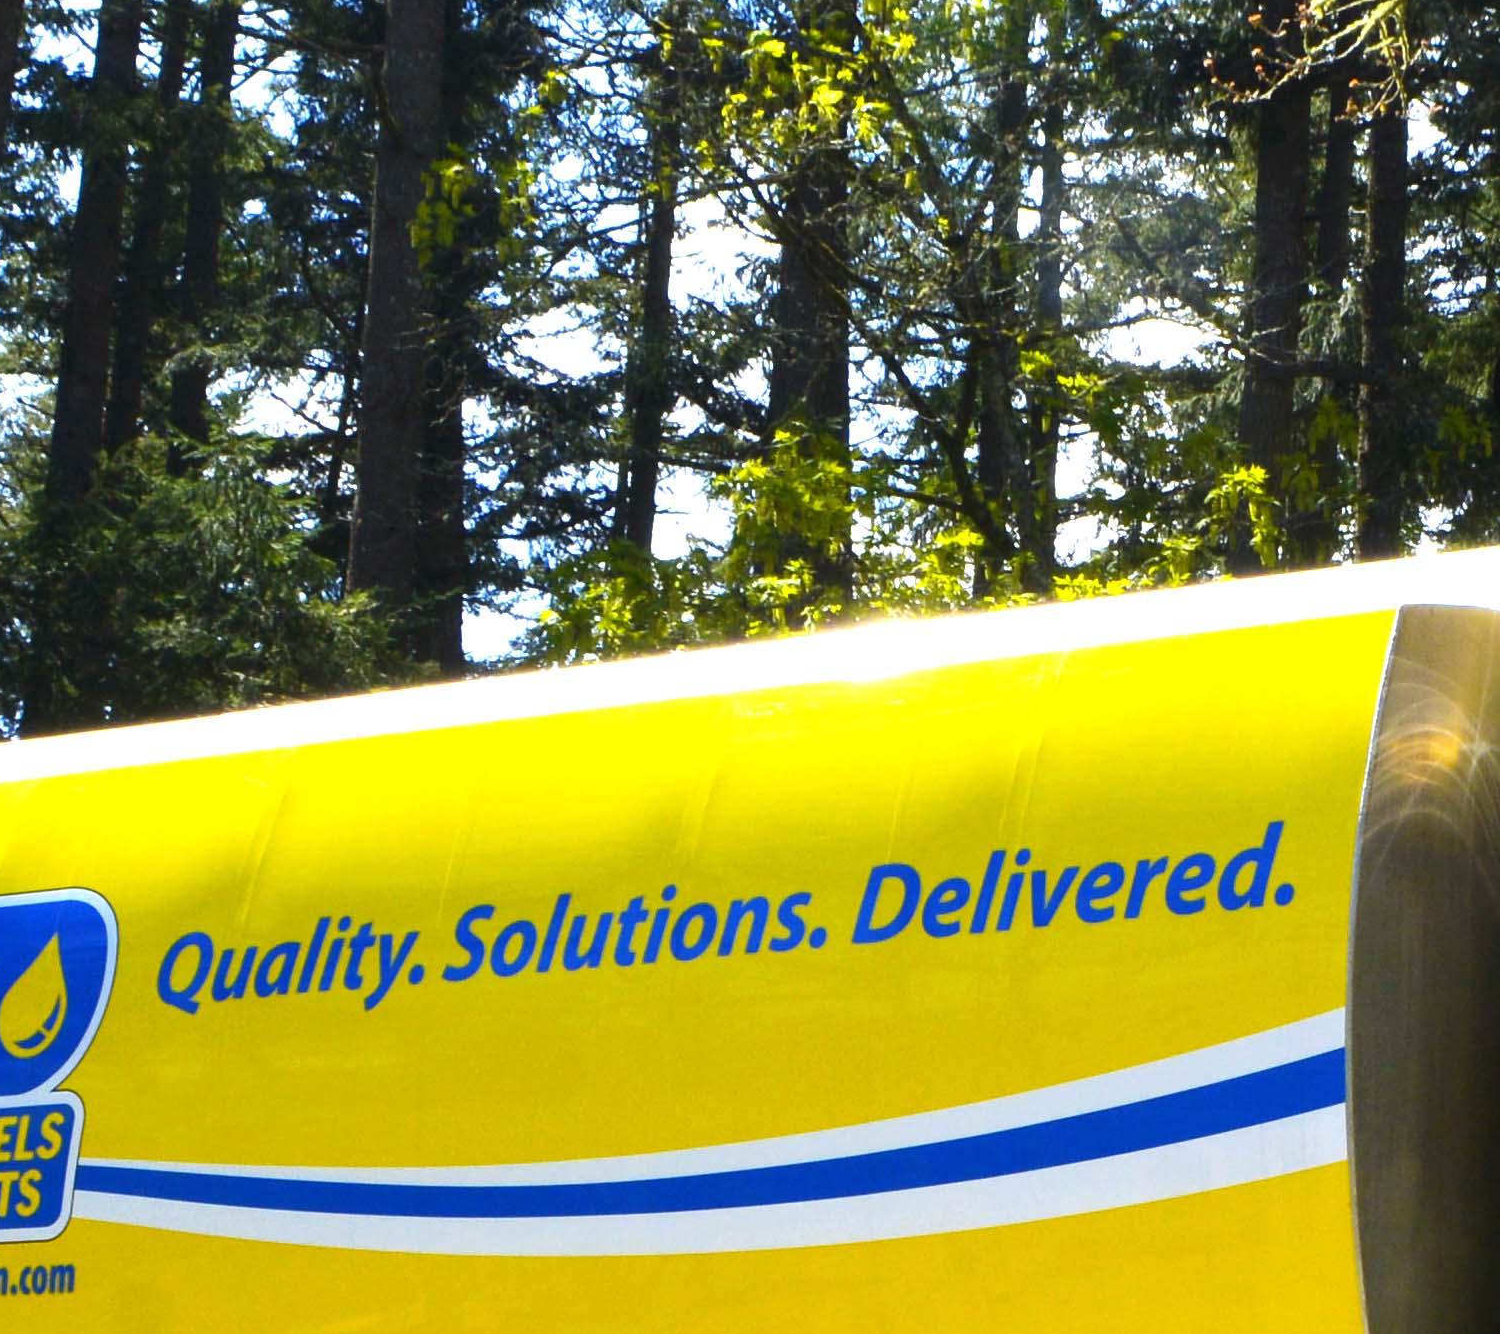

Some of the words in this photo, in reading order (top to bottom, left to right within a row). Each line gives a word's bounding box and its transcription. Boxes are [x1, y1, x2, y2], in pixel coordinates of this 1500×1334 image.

[158, 917, 425, 1014] Quality.
[443, 885, 828, 982] Solutions.
[852, 821, 1295, 944] Delivered.
